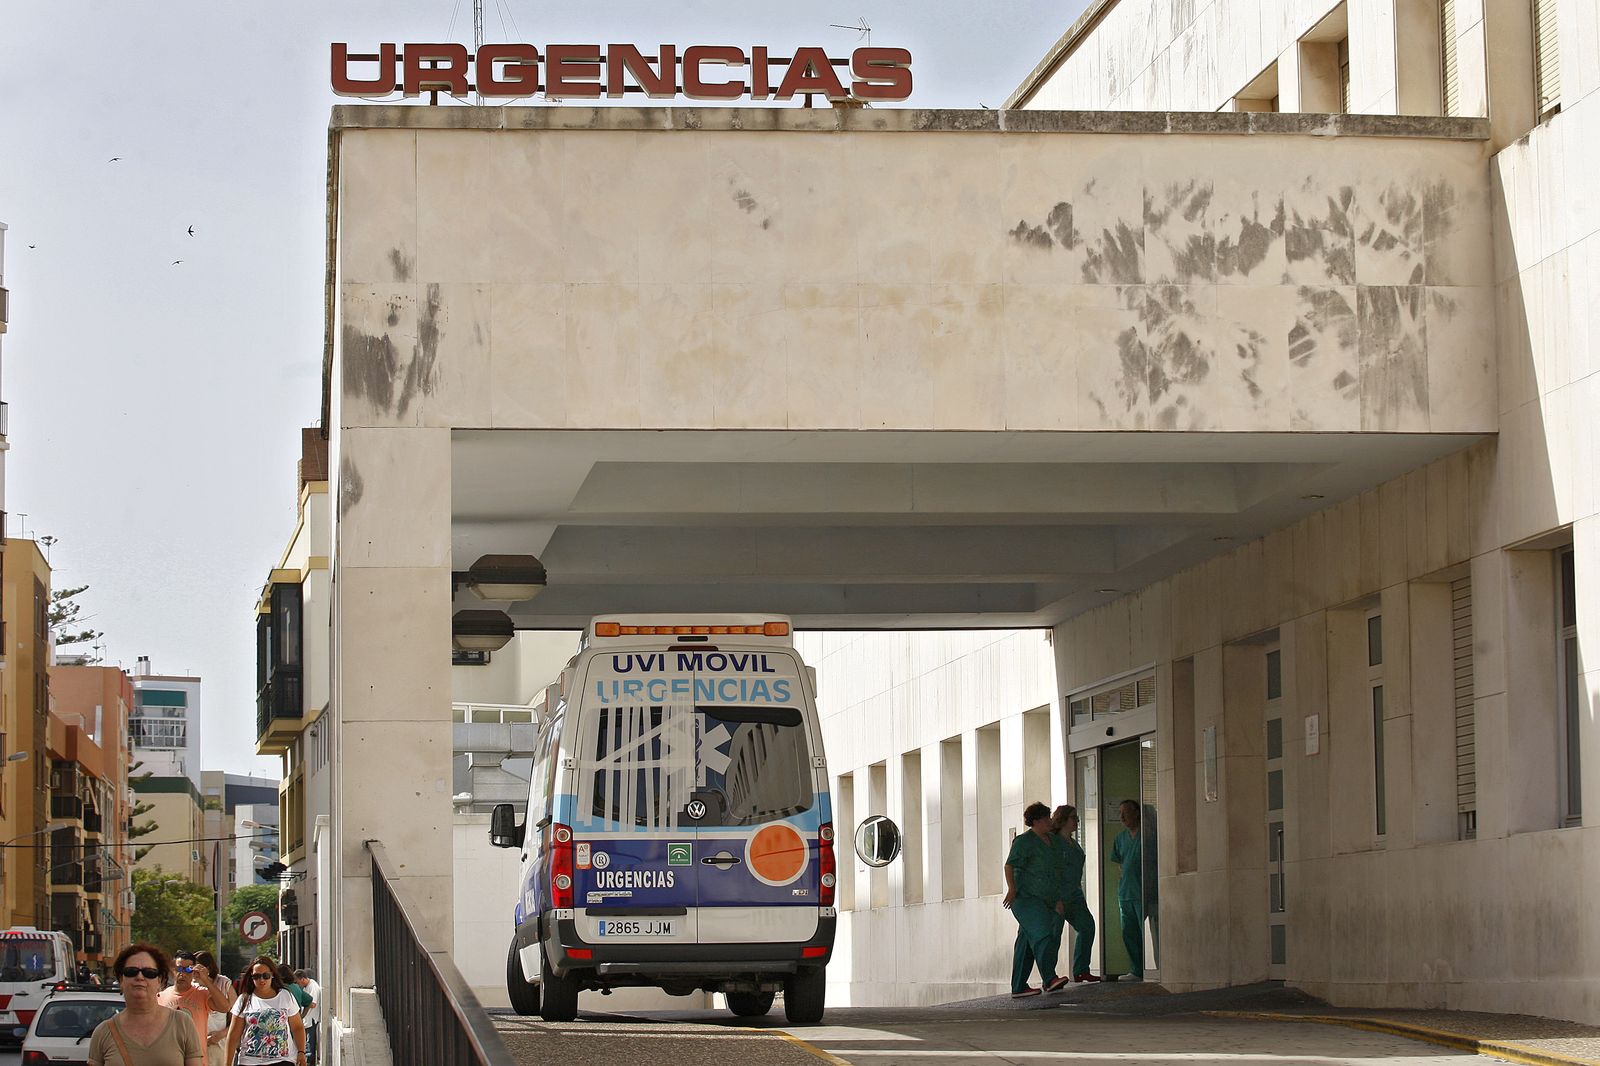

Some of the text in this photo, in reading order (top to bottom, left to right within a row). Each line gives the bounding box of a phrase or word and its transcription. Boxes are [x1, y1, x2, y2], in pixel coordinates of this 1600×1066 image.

[331, 42, 913, 100] URGENCIAS
[612, 653, 776, 673] UVI MOVIL
[596, 870, 675, 889] URGENCIAS
[607, 922, 640, 935] 2865
[645, 922, 671, 935] JJM
